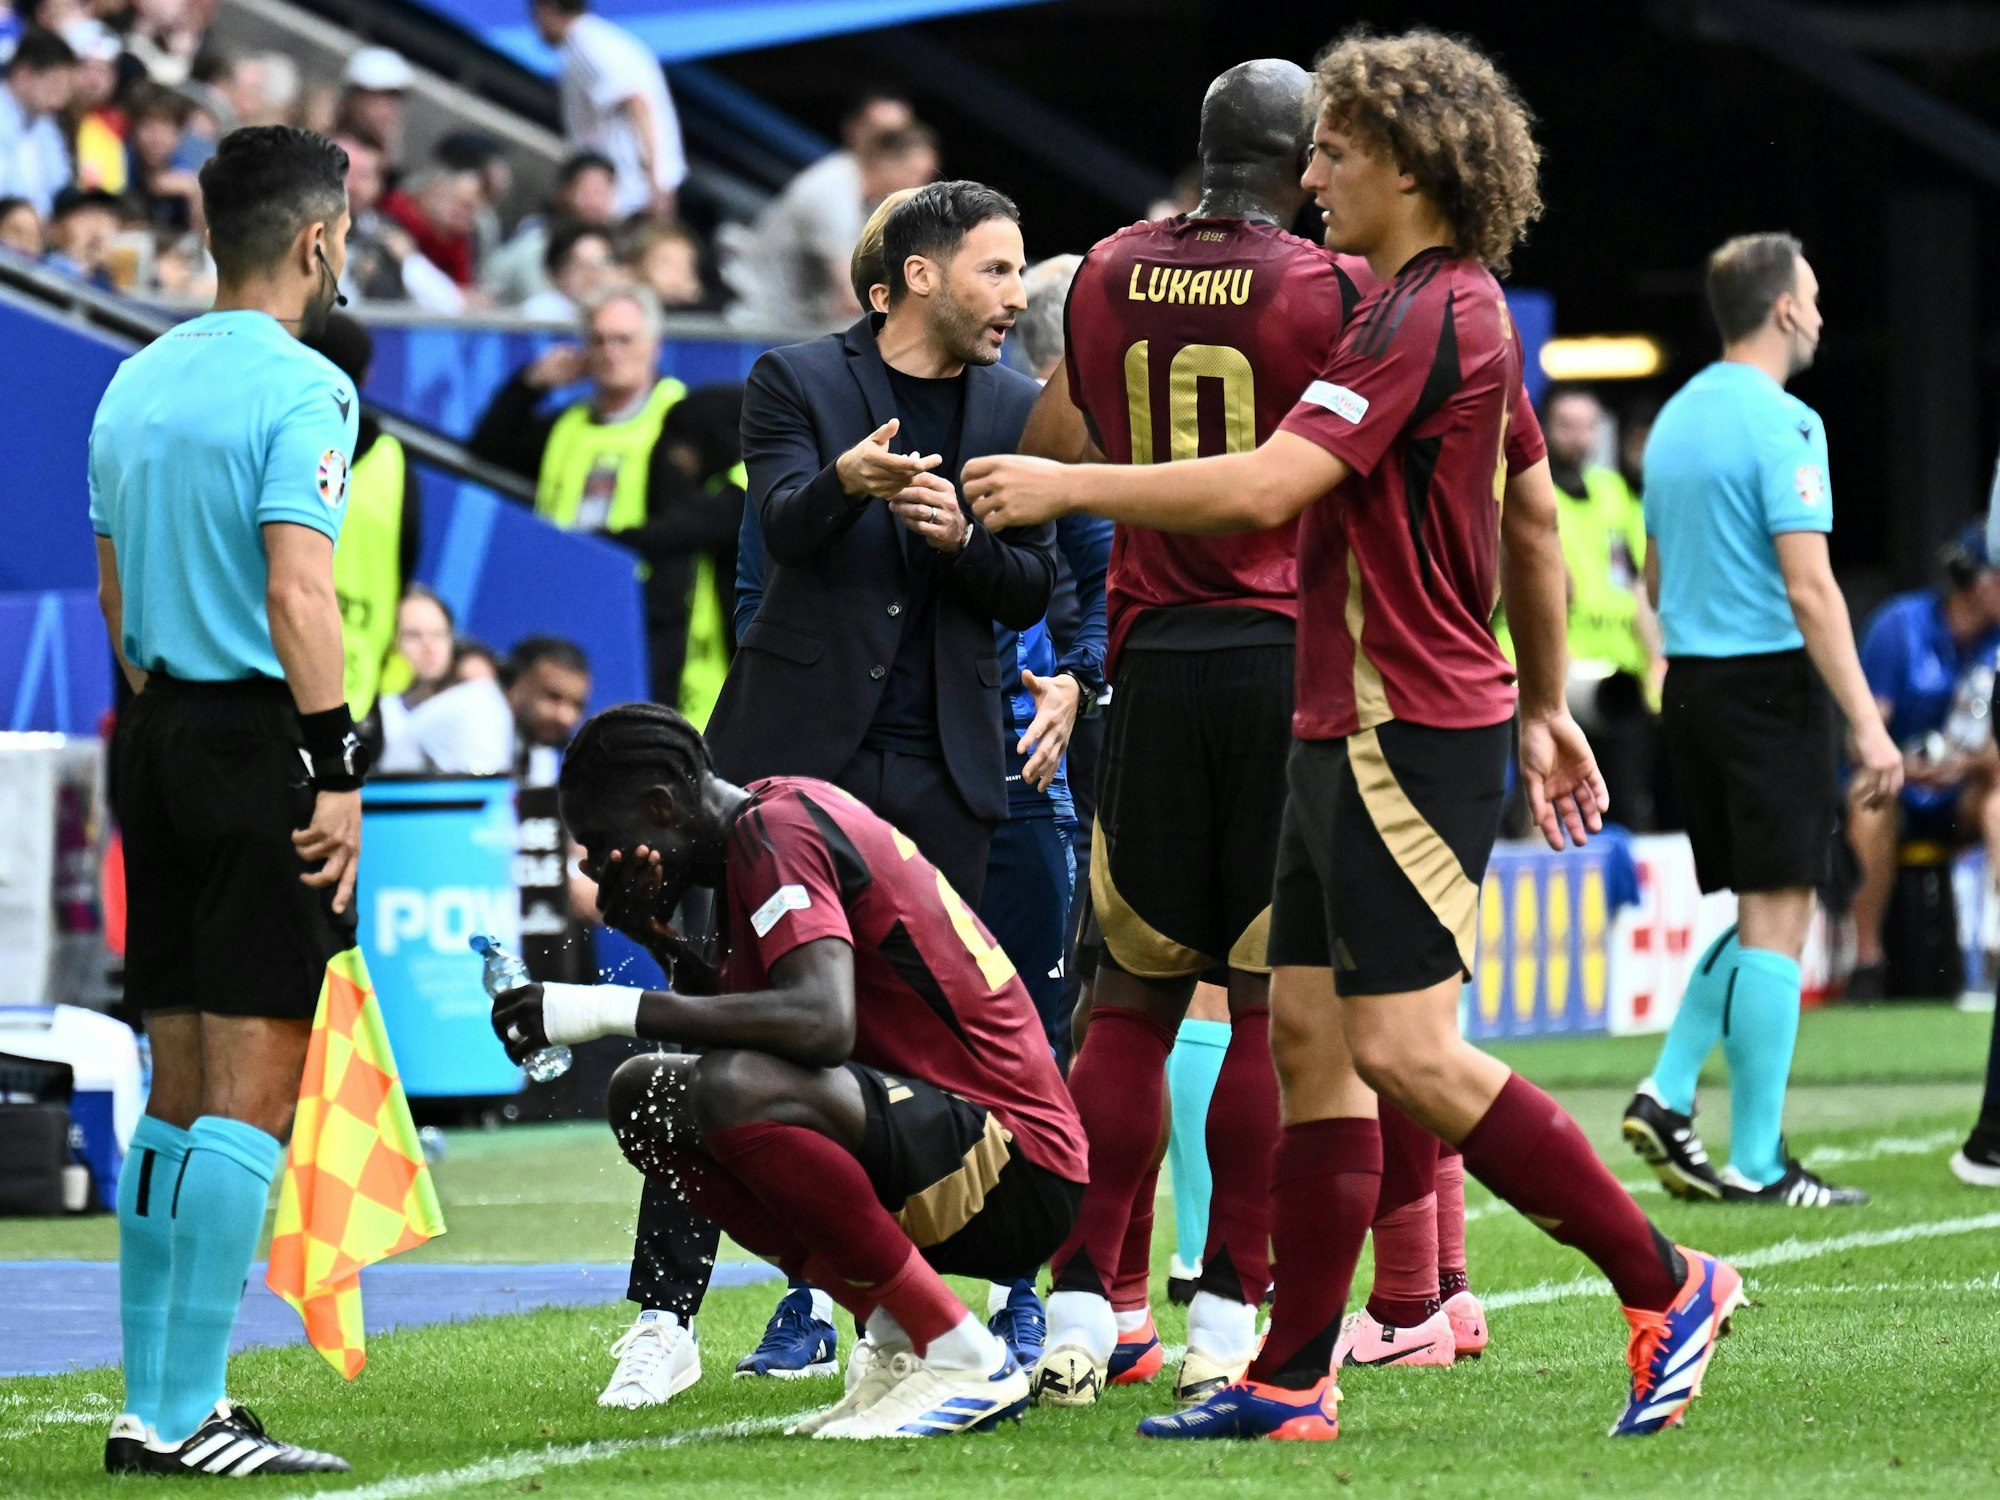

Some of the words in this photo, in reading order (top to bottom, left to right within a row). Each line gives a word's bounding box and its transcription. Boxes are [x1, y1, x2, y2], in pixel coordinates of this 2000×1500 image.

[1194, 231, 1227, 243] 1895
[1128, 263, 1253, 305] LUKAKU
[1124, 339, 1256, 465] 10
